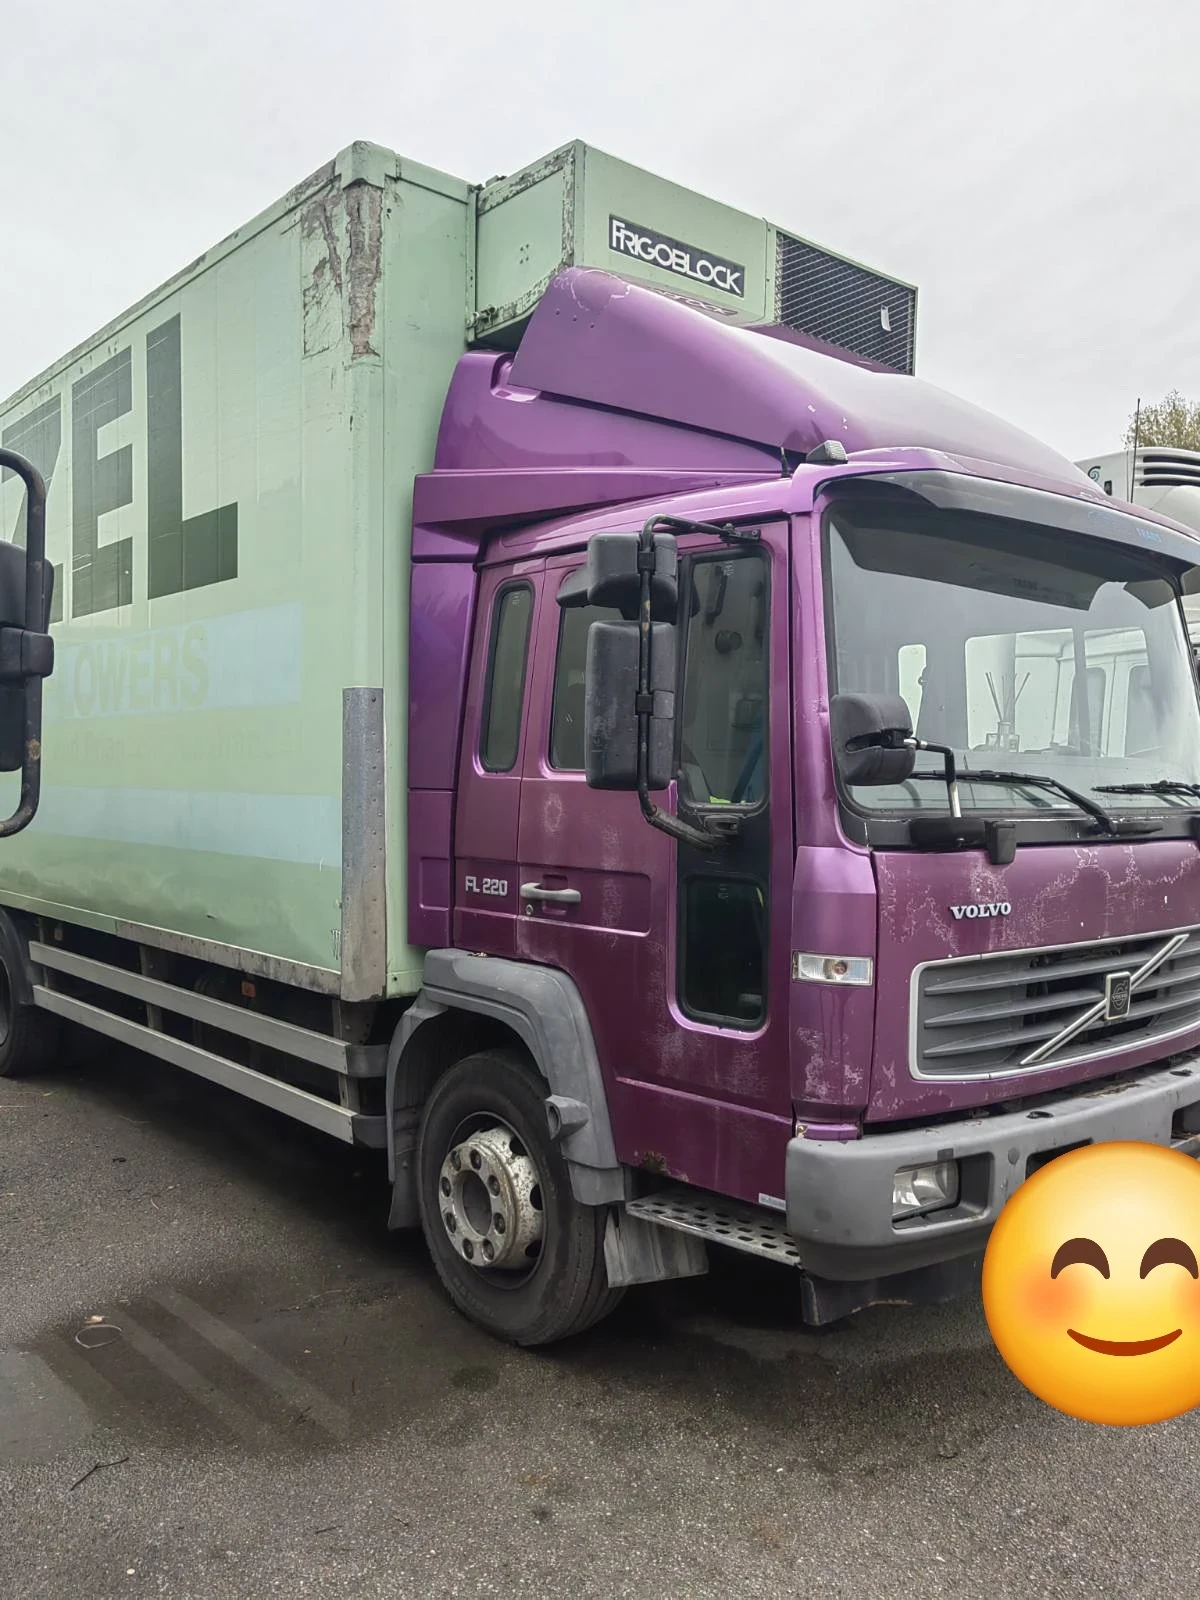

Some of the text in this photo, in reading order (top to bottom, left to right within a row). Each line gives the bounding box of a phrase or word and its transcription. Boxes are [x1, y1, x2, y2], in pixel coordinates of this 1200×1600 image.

[612, 220, 741, 294] FRIGOBLOCK
[465, 875, 508, 896] FL 220
[950, 902, 1011, 920] VOLVO
